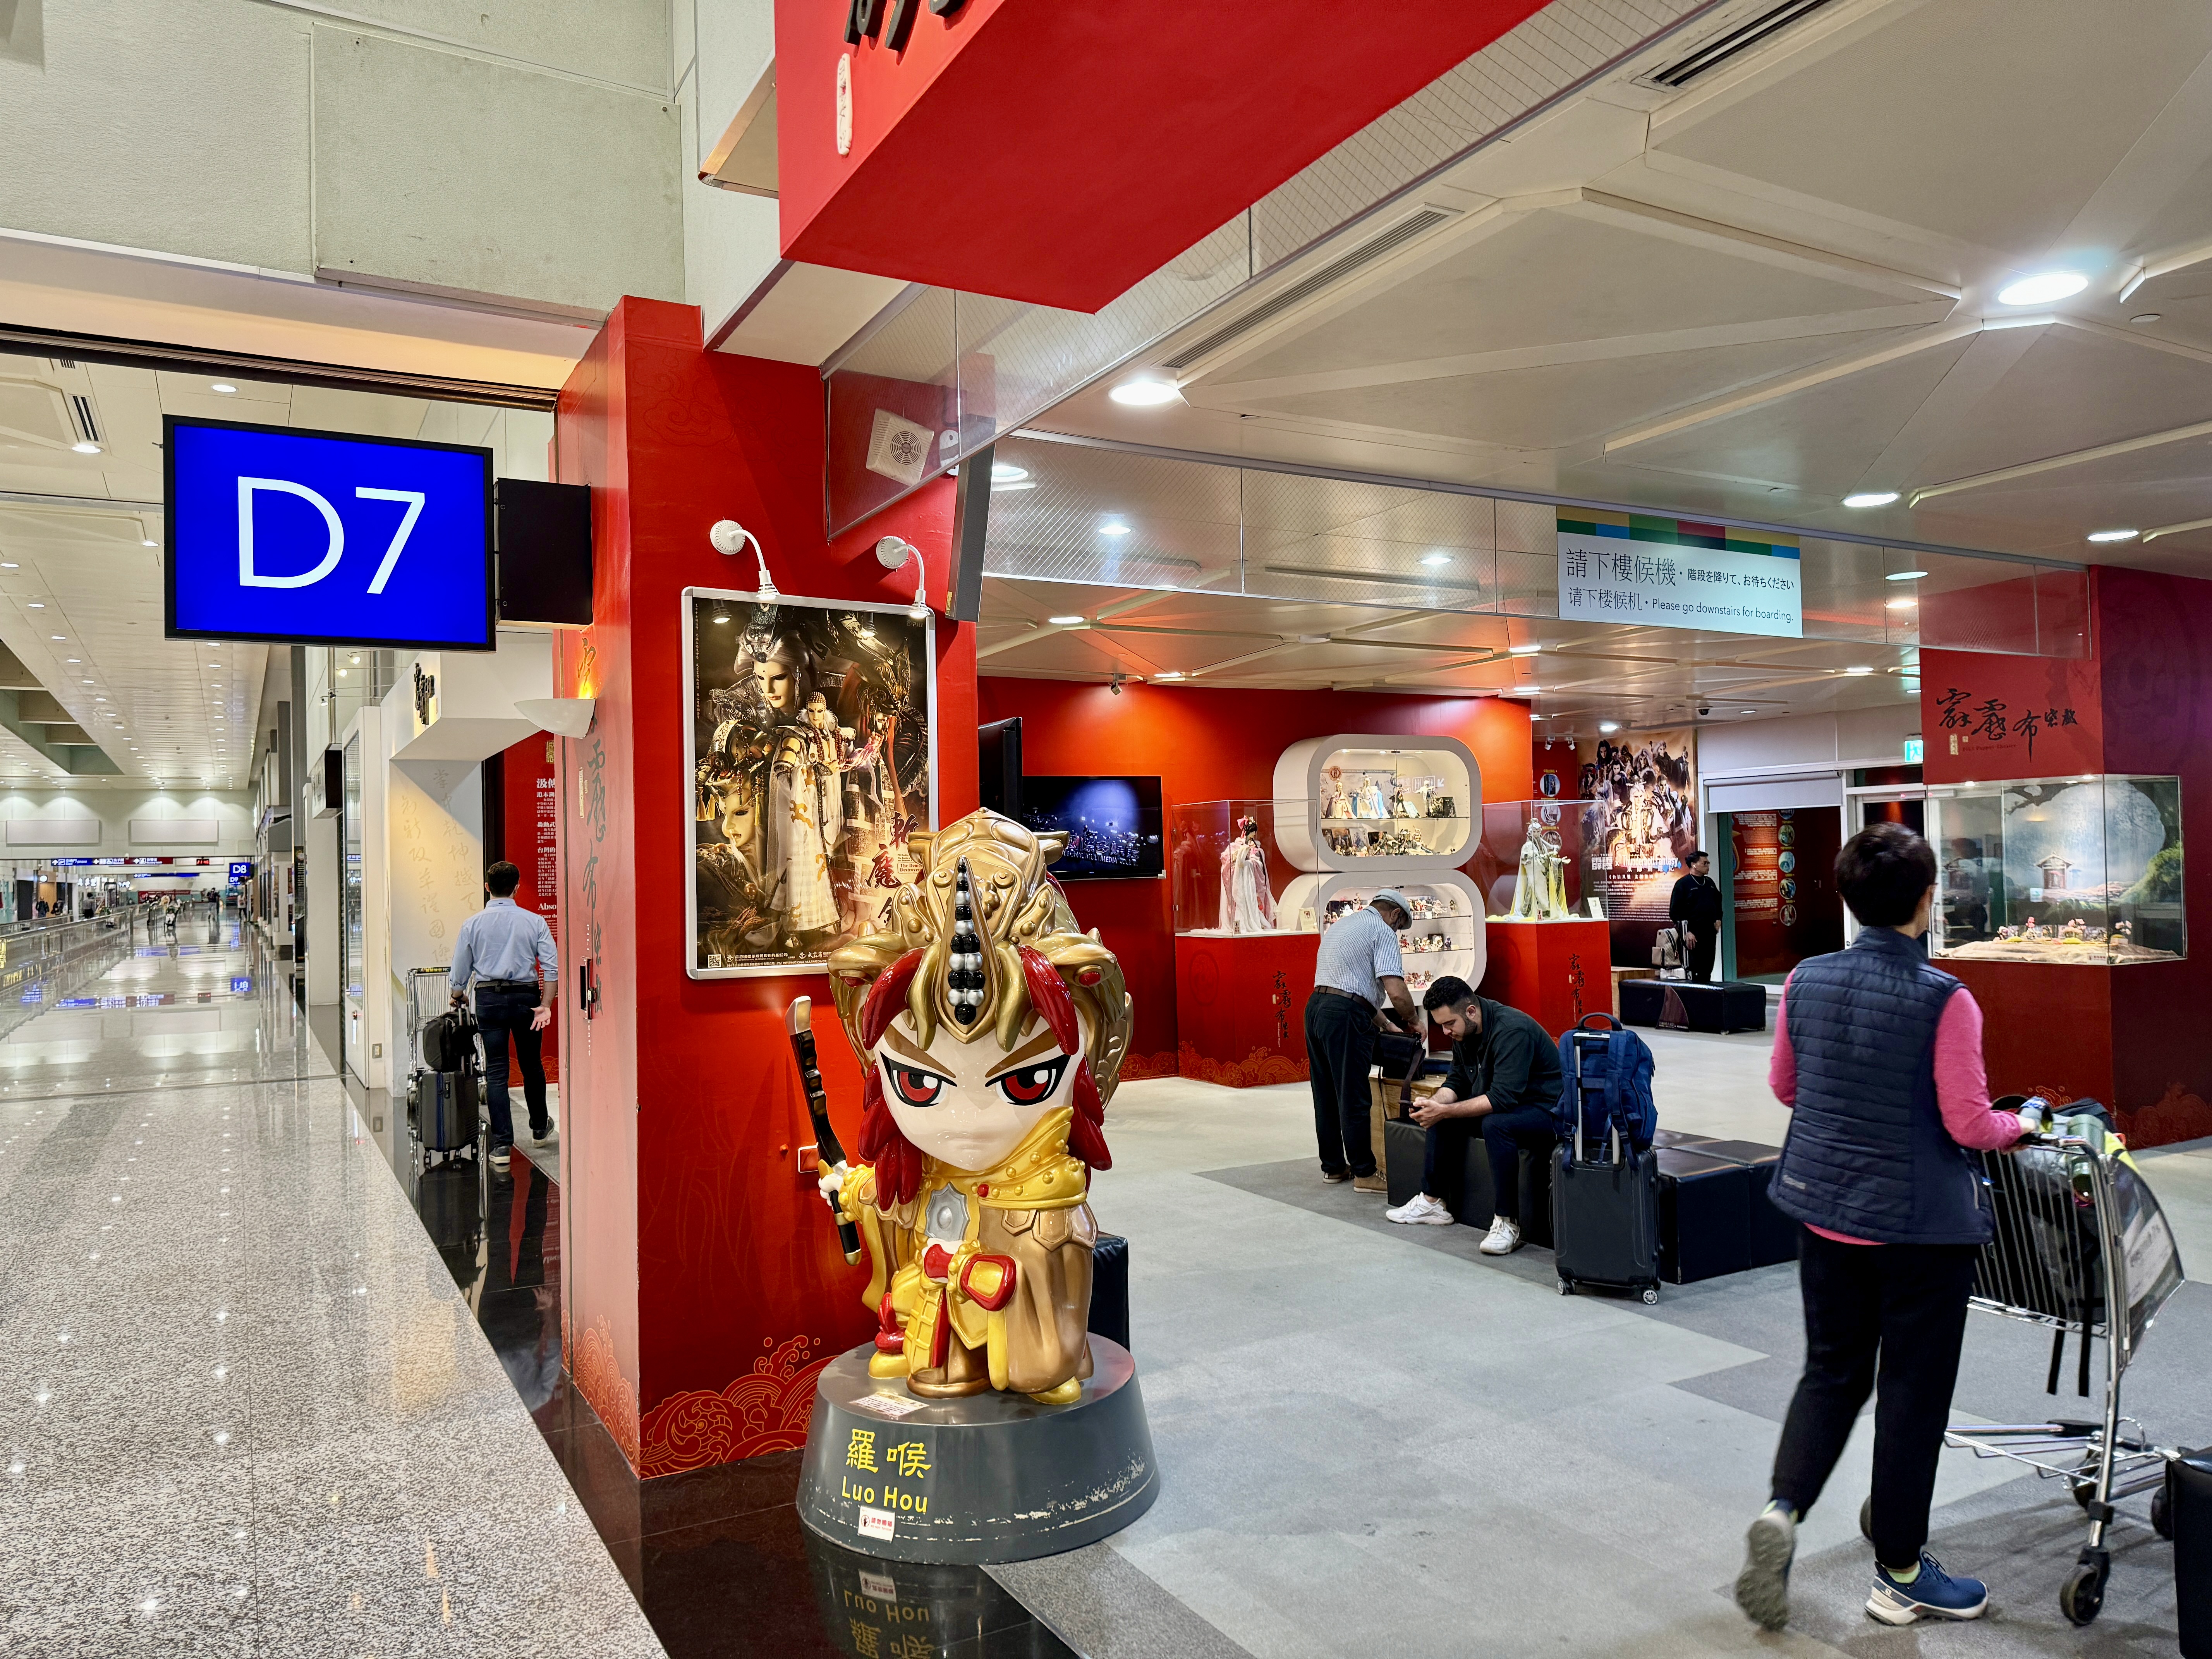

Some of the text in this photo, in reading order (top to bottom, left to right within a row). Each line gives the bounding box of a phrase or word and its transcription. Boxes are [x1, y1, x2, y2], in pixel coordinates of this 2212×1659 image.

[237, 476, 425, 594] D7
[1566, 548, 1676, 587] 請下樓候機
[1568, 586, 1793, 623] 请下楼候机 Please go downstairs for boarding.
[233, 865, 247, 874] D8
[842, 1476, 928, 1513] Luo Hou
